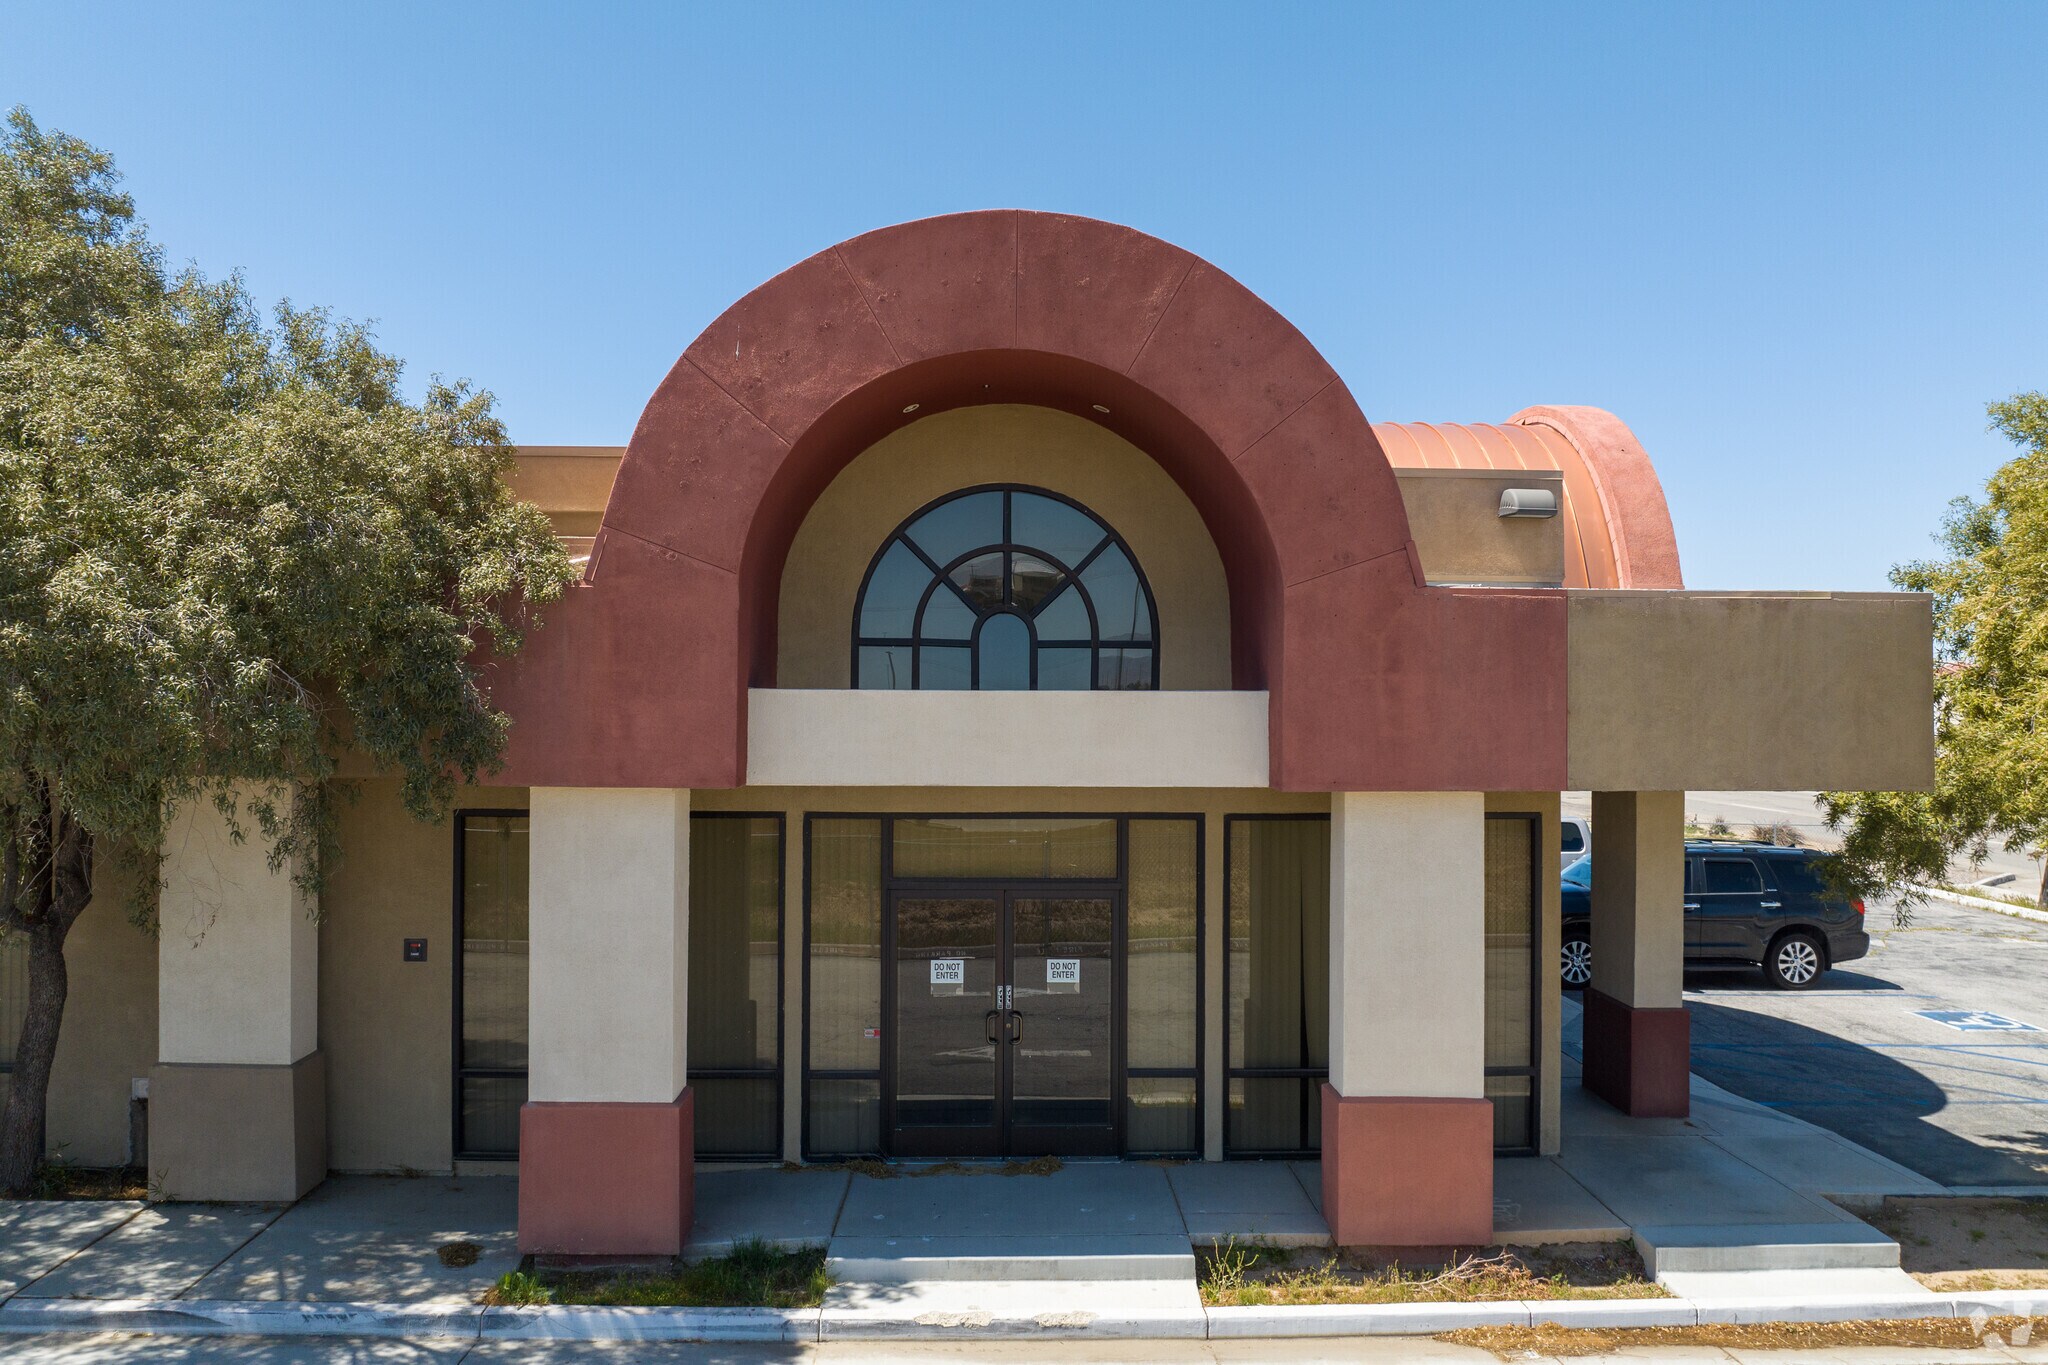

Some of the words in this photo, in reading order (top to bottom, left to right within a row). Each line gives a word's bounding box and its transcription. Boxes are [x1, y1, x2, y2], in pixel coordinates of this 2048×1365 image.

[934, 963, 944, 971] DO
[946, 963, 960, 971] NOT
[1051, 962, 1061, 970] DO
[1062, 962, 1076, 970] NOT
[936, 971, 959, 979] ENTER
[1052, 970, 1075, 978] ENTER
